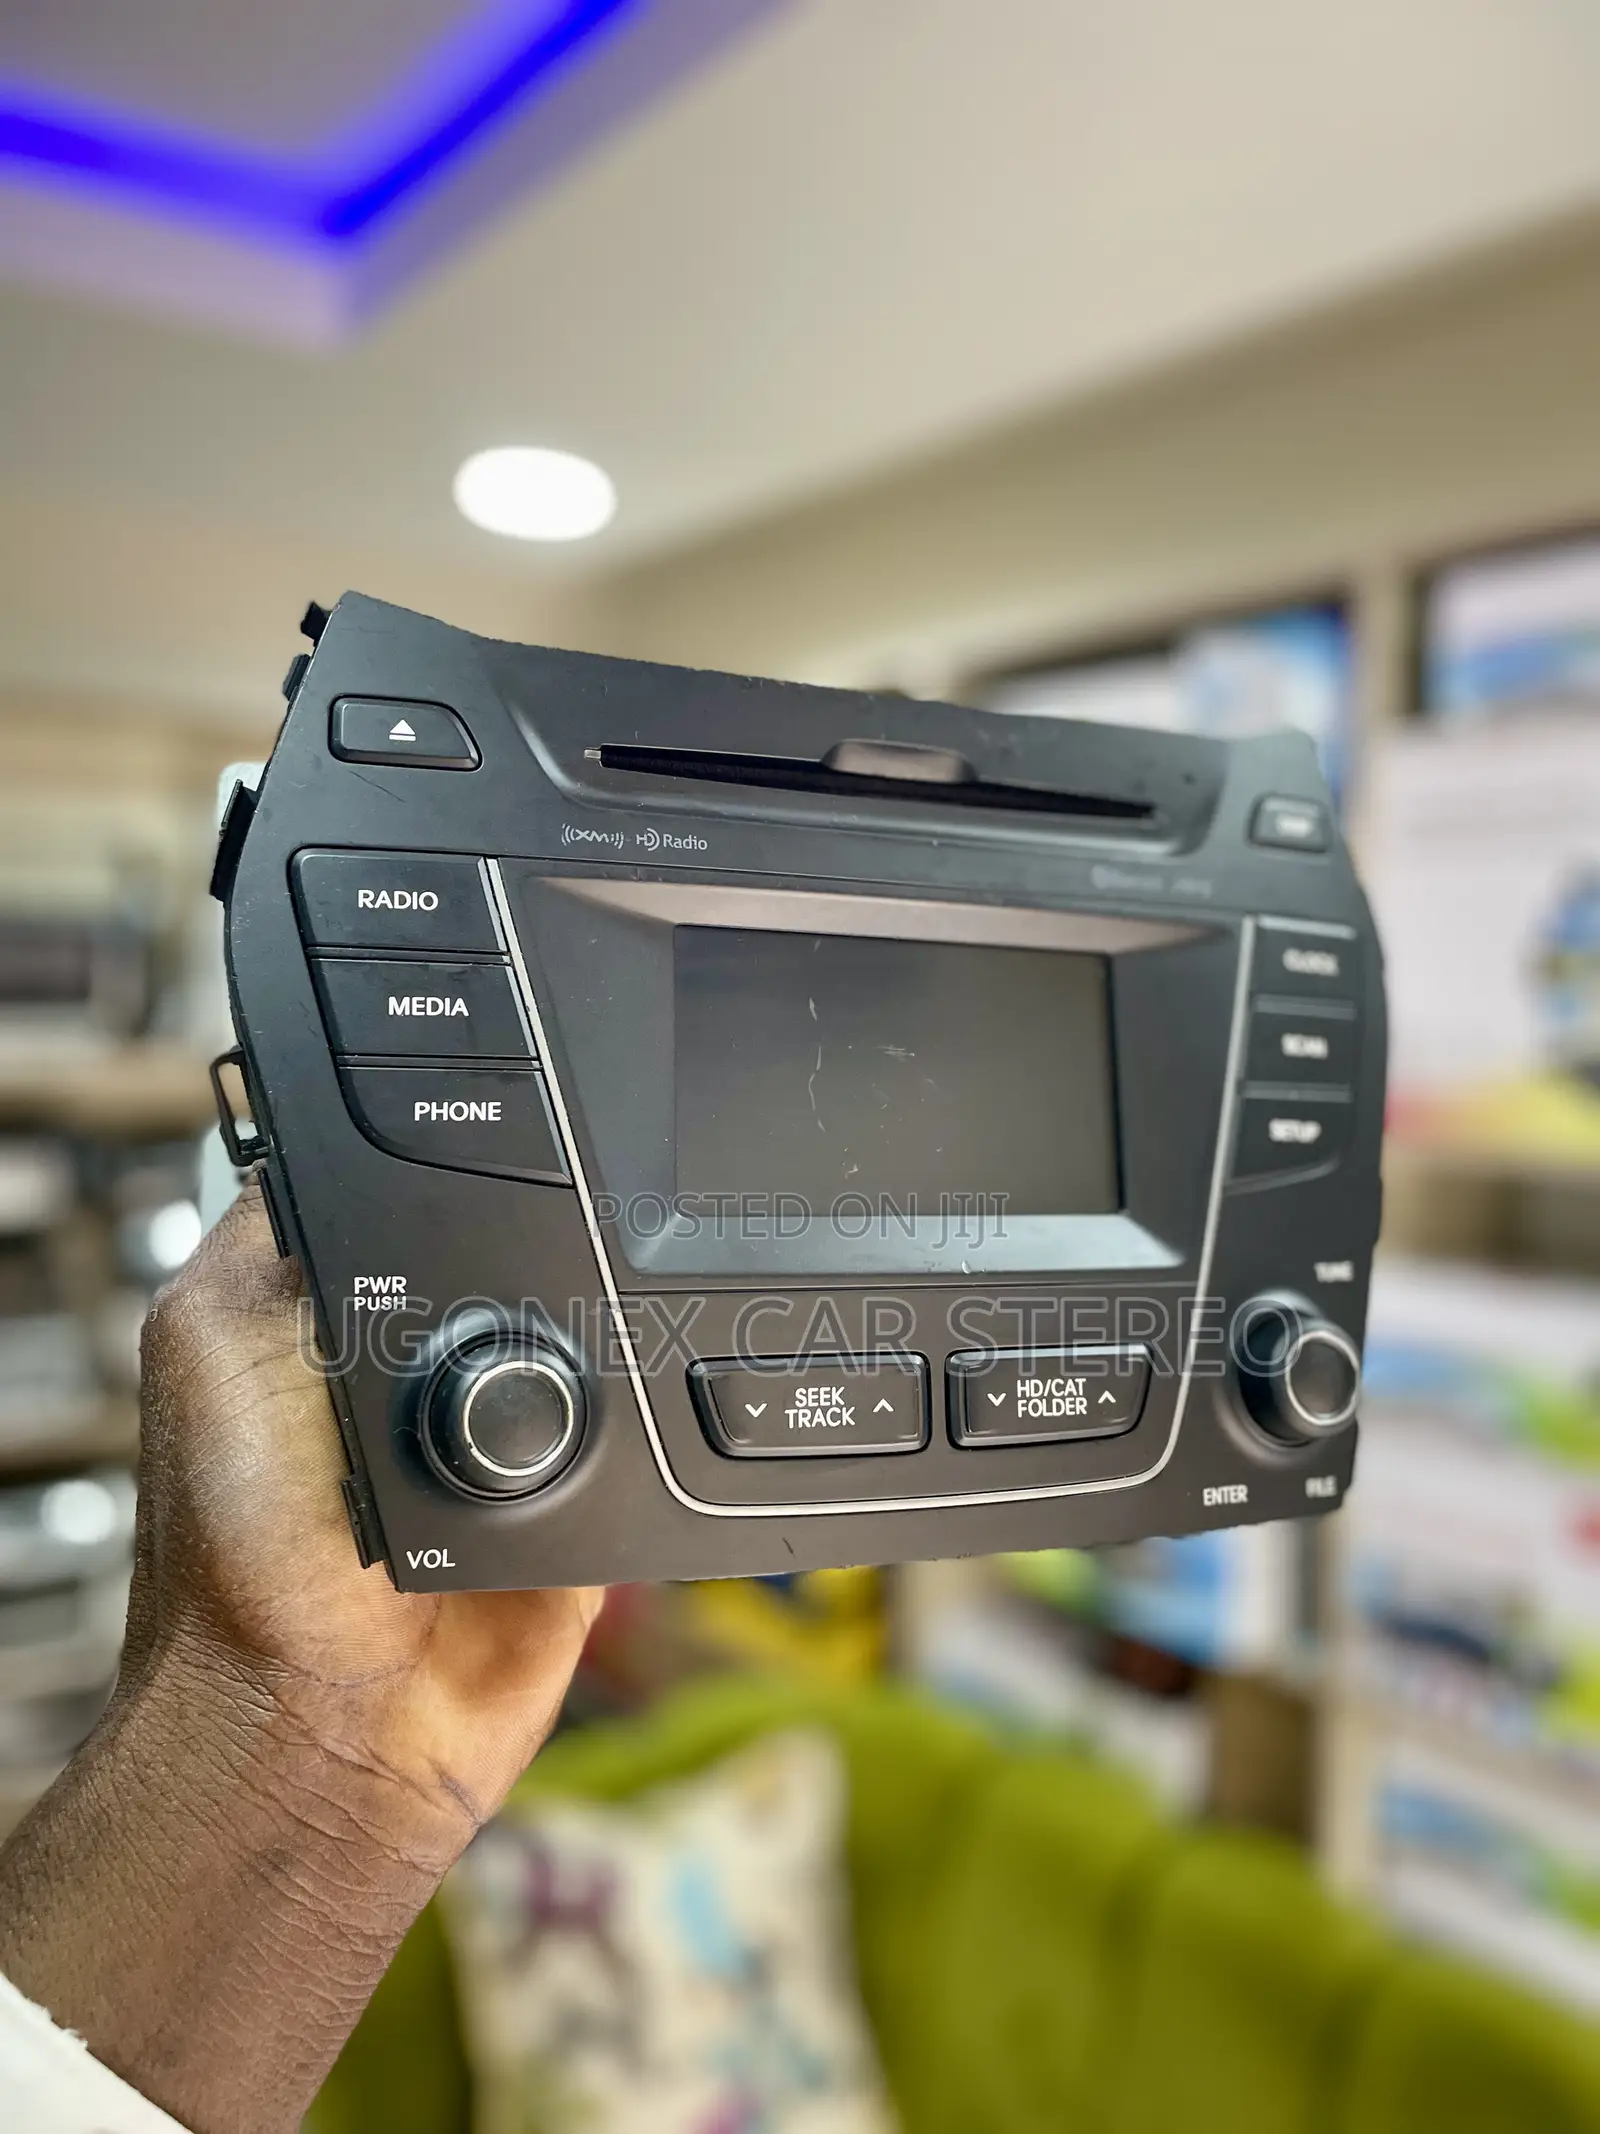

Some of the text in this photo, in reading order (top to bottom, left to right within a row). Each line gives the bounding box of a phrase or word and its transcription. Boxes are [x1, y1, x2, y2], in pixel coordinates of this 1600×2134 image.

[663, 833, 708, 851] Radio
[357, 889, 439, 911] RADIO
[387, 996, 469, 1018] MEDIA
[413, 1101, 502, 1122] PHONE
[353, 1275, 407, 1294] PWR
[353, 1295, 407, 1312] PUSH
[795, 1386, 845, 1407] SEEK
[1016, 1378, 1087, 1398] HD/CAT
[784, 1405, 856, 1429] TRACK
[1017, 1396, 1088, 1418] FOLDER
[1202, 1484, 1249, 1507] ENTER
[406, 1548, 456, 1570] VOL
